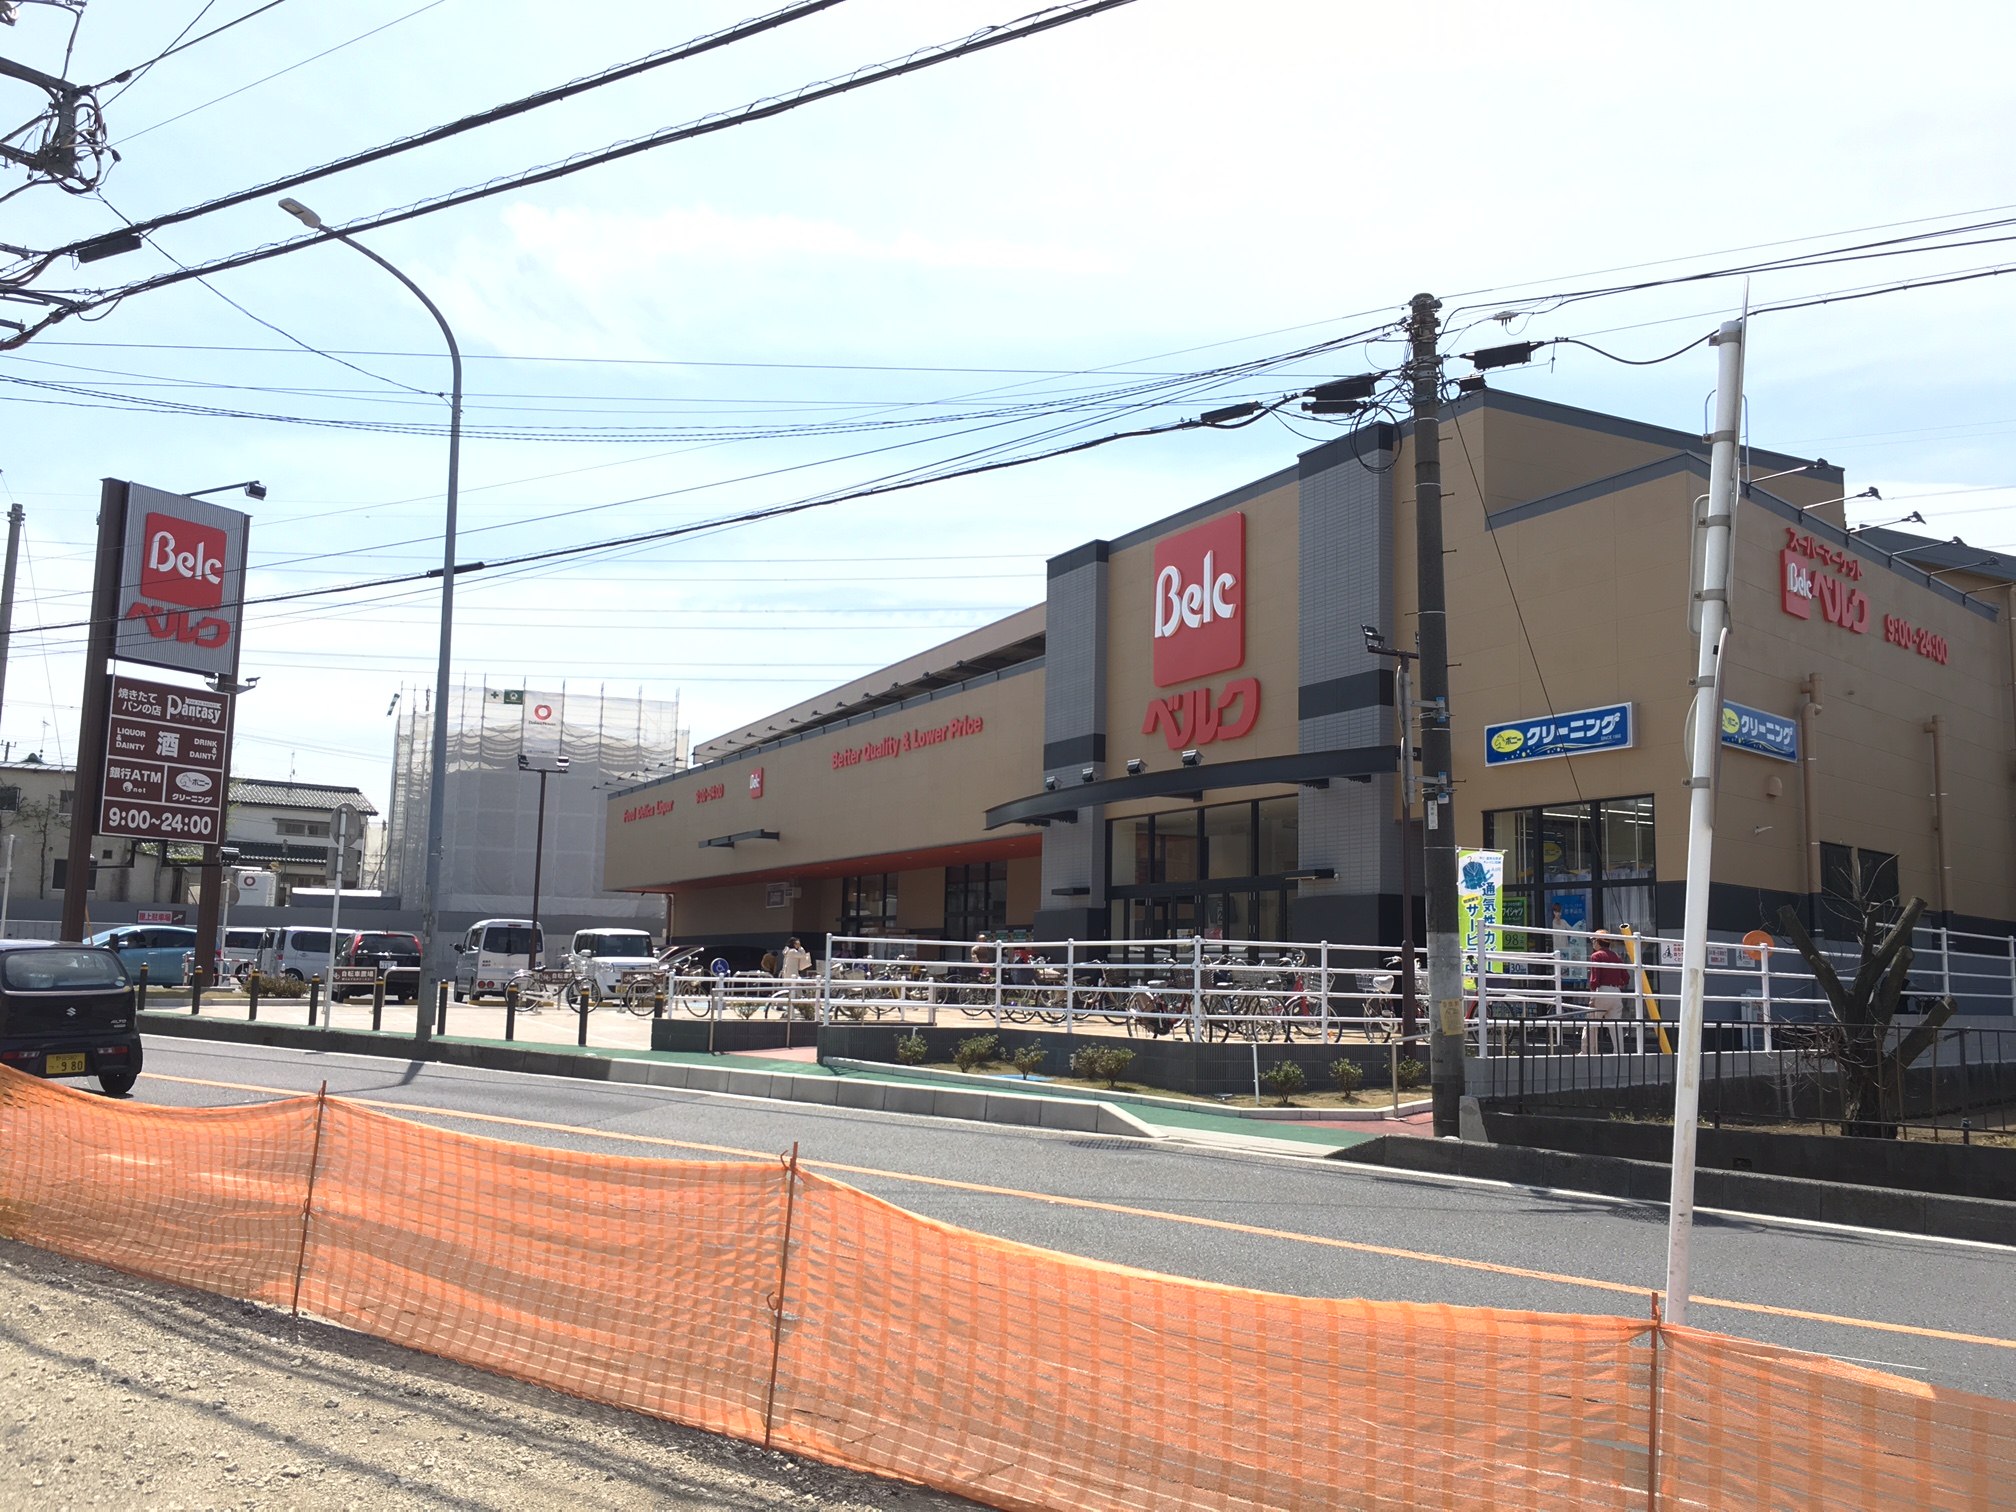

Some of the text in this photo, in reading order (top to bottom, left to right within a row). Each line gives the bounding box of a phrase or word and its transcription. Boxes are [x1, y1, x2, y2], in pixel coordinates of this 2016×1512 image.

[148, 530, 222, 585] Belc
[1785, 527, 1862, 581] スーパーマーケット
[1155, 550, 1236, 638] Belc
[1787, 562, 1812, 600] Belc
[1811, 570, 1871, 634] ベルク
[125, 601, 231, 649] ベルク
[118, 687, 158, 704] 焼きたて
[121, 700, 162, 717] パンの店
[166, 694, 221, 724] Pantasy
[1142, 677, 1260, 750] ベルク
[117, 727, 146, 738] LIQUOR
[194, 738, 218, 747] DRINK
[832, 715, 983, 769] Better Quality & Lower Price
[1527, 712, 1621, 746] クリーニング
[1741, 715, 1793, 745] クリーニング
[115, 741, 145, 751] DAINTY
[155, 731, 180, 758] 酒
[189, 751, 217, 761] DAINTY
[109, 766, 162, 784] 銀行ATM
[172, 793, 213, 804] クリーニング
[624, 810, 637, 823] Food
[656, 800, 675, 816] Liquor
[109, 807, 212, 835] 9:00~24:00
